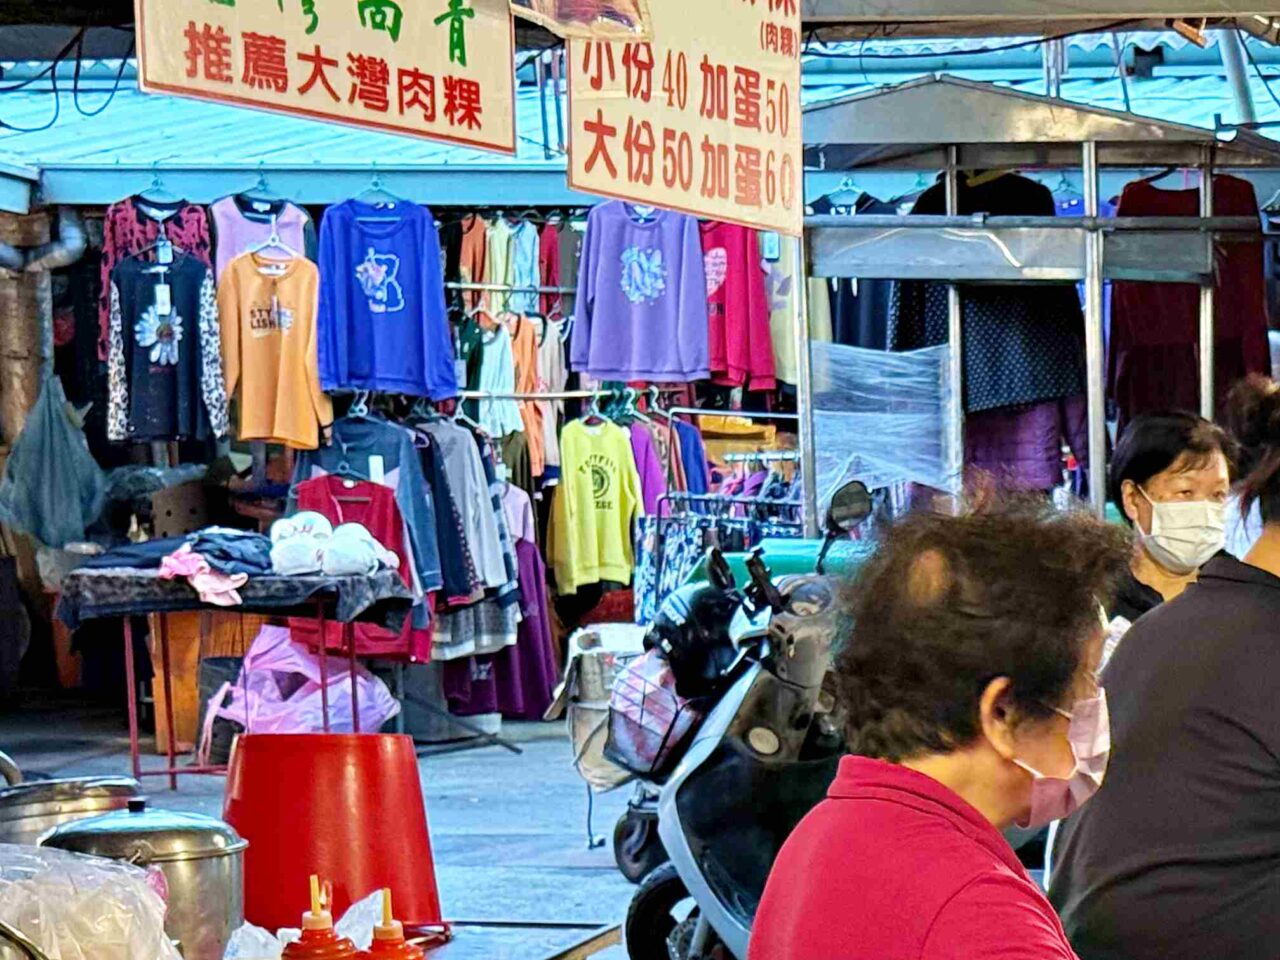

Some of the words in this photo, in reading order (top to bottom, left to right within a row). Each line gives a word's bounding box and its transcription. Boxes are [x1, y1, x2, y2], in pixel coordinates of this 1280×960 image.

[183, 20, 483, 131] 推薦大灣肉粿
